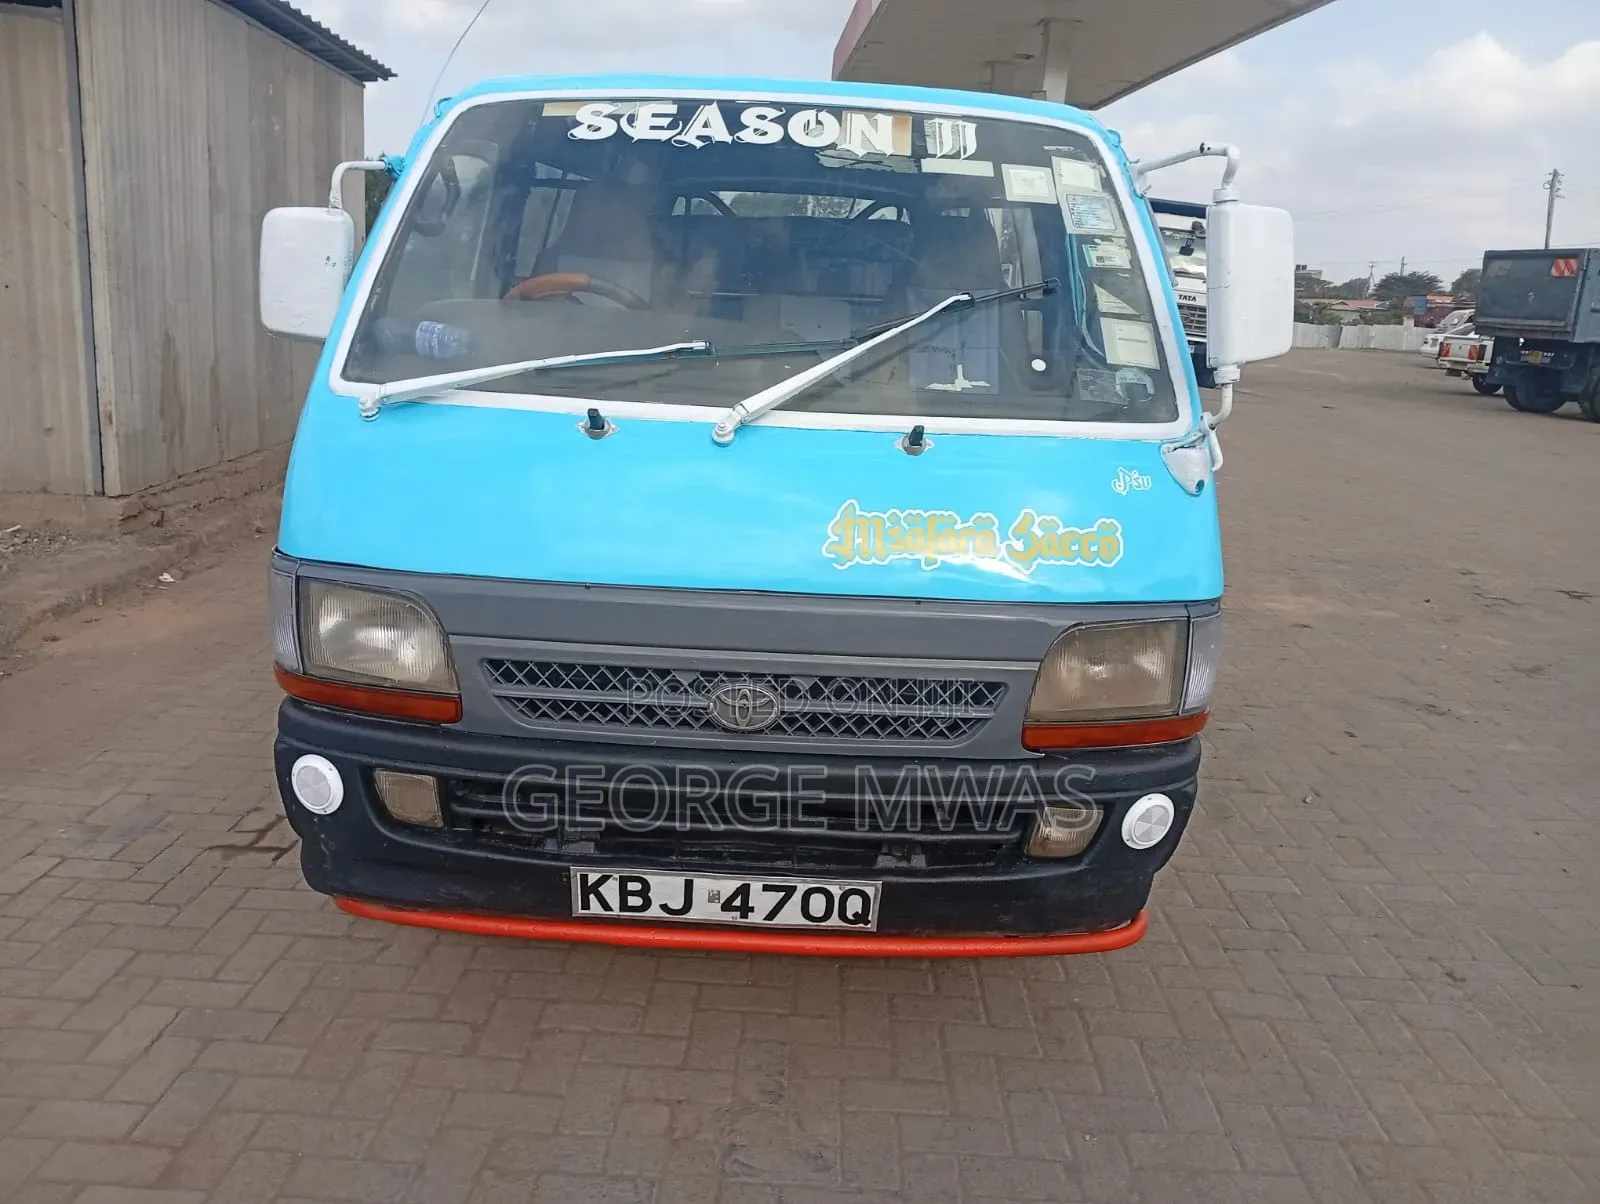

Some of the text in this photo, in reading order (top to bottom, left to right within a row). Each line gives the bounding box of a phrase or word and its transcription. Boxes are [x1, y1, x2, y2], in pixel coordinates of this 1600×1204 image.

[567, 100, 895, 157] SEASON
[1178, 294, 1197, 302] TATA
[580, 873, 872, 927] KBJ 470Q
